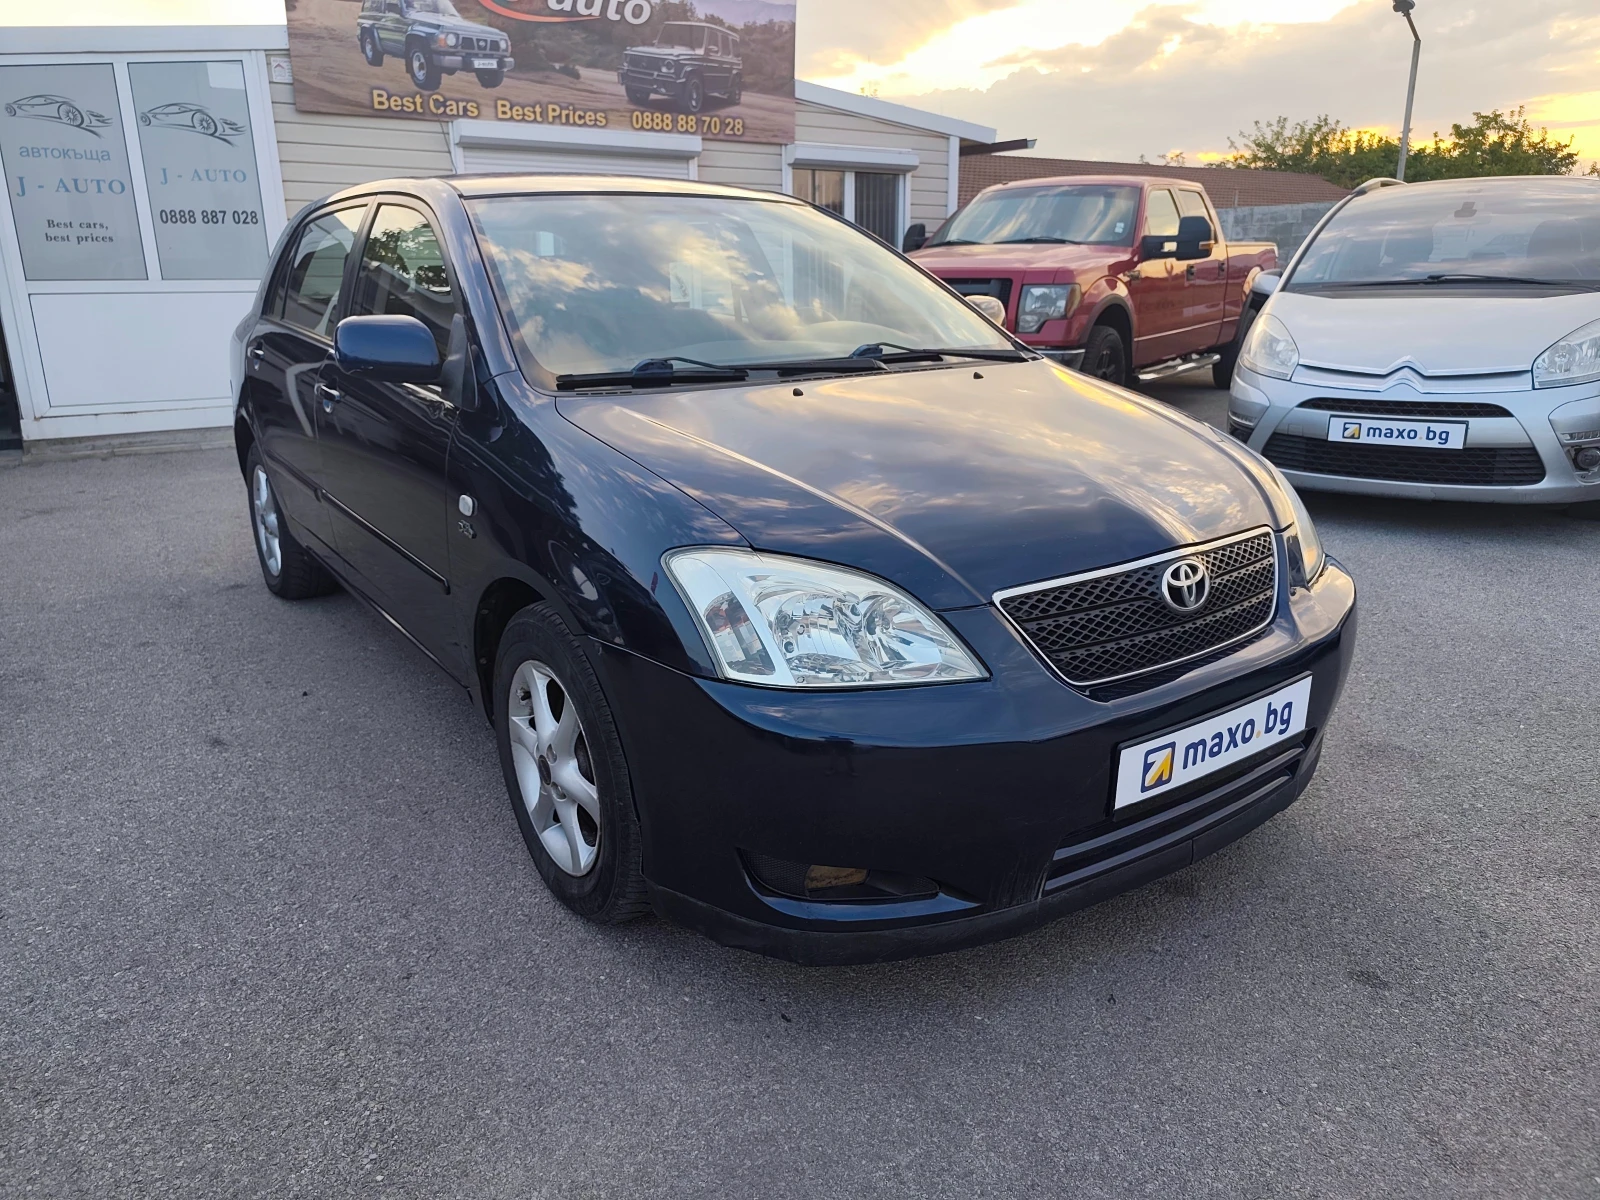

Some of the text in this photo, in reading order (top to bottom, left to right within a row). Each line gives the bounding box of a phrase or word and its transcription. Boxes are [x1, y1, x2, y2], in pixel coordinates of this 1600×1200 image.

[372, 89, 744, 136] Best Cars Best Prices 0888 88 70 28
[19, 145, 111, 163] автокъща
[161, 167, 168, 185] J
[191, 168, 247, 183] AUTO
[16, 176, 26, 197] J
[55, 177, 126, 195] AUTO
[46, 219, 109, 231] Best cars,
[160, 209, 259, 225] 0888 887 028
[45, 232, 114, 245] best prices
[1366, 426, 1450, 445] maxo.bg
[1182, 701, 1293, 770] maxo.bg
